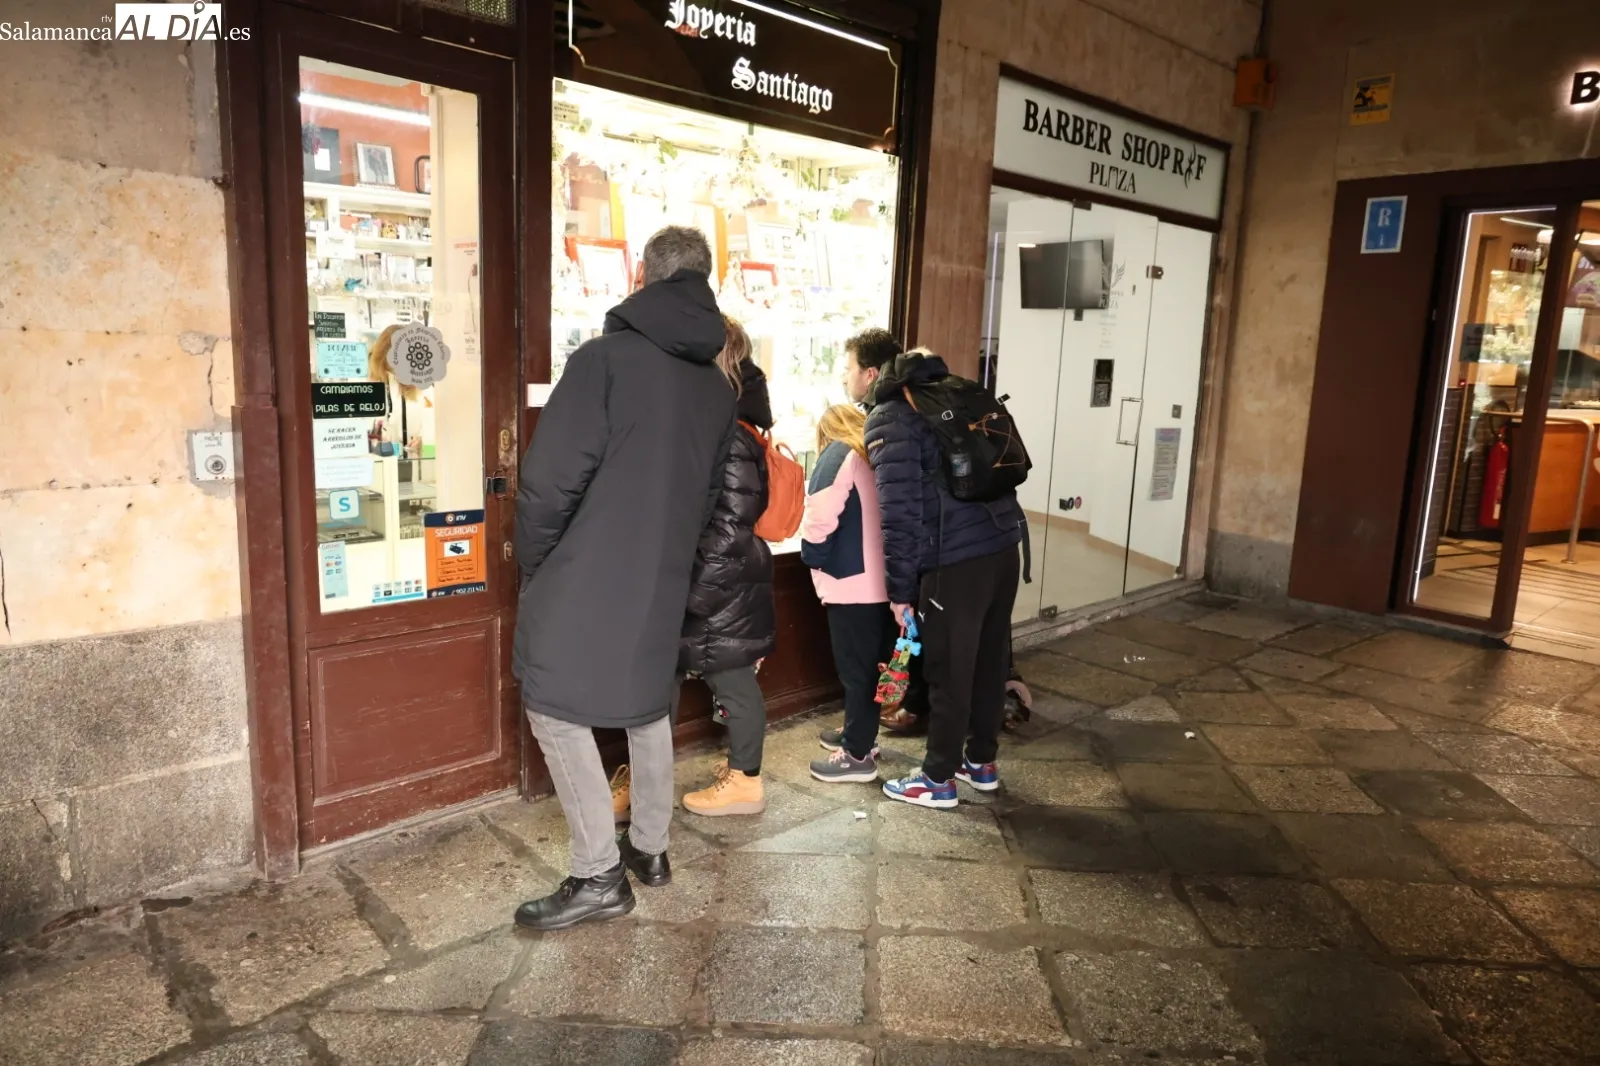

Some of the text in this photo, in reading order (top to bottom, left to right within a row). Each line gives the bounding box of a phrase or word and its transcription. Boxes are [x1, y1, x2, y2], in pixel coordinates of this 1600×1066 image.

[731, 56, 833, 115] Santiago
[1023, 98, 1112, 156] BARBER
[1378, 207, 1392, 227] R
[320, 385, 374, 394] CAMBIAMOS
[315, 402, 385, 413] PILAS DE RELOJ
[338, 497, 351, 512] S
[435, 525, 478, 538] SEGURIDAD
